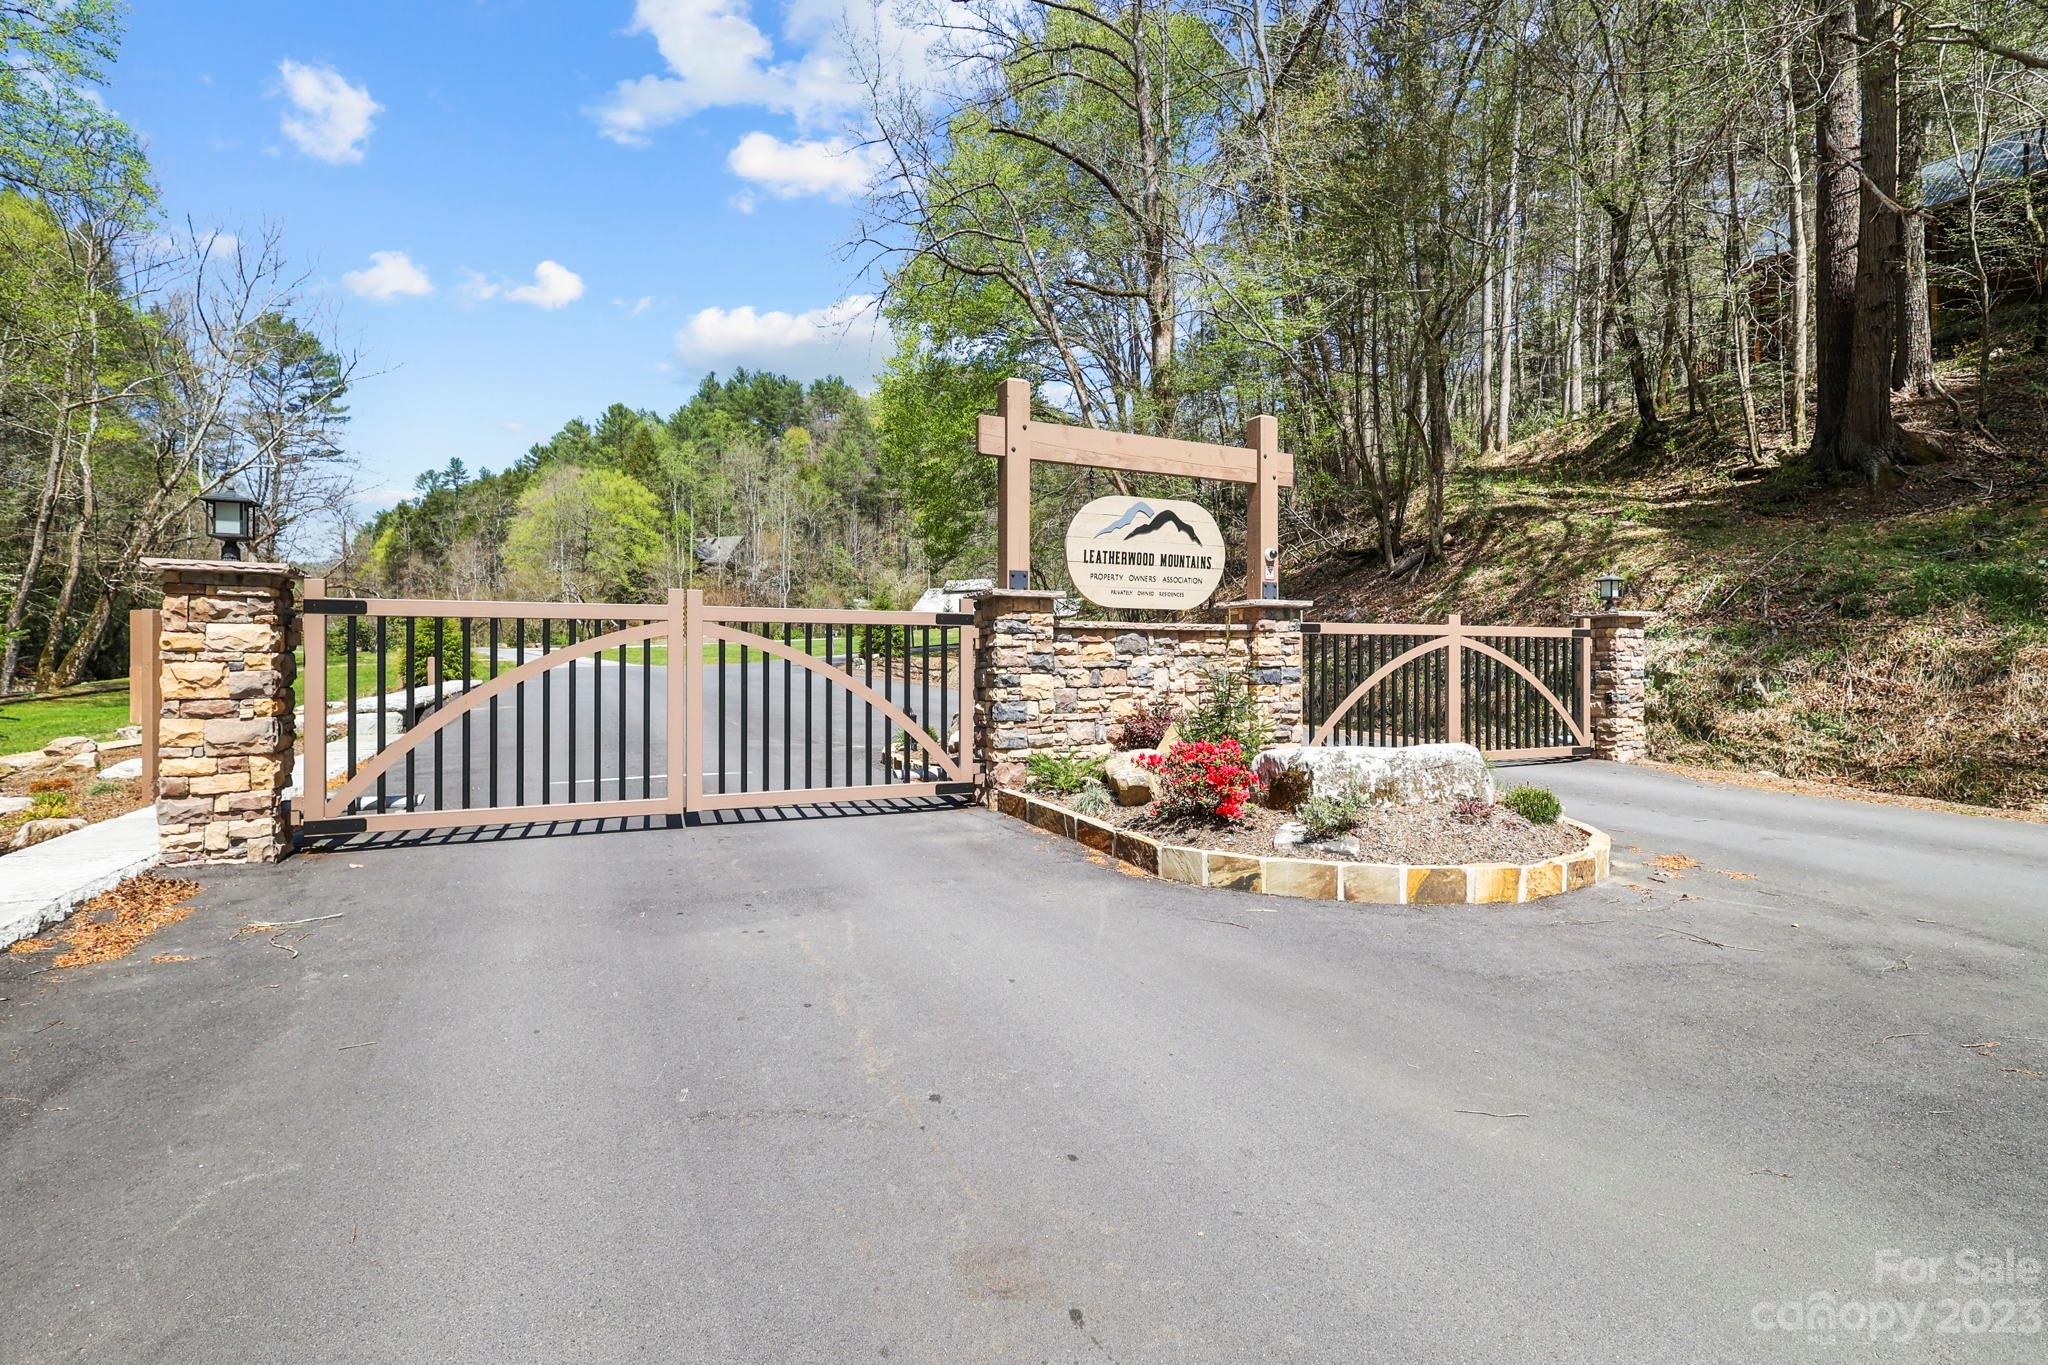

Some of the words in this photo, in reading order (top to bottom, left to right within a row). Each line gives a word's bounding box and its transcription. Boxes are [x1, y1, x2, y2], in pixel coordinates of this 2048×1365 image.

[1083, 549, 1155, 566] LEATHERWOOD
[1160, 553, 1212, 569] MOUNTAINS
[1090, 572, 1123, 581] PROPERTY
[1128, 574, 1156, 583] OWNERS
[1162, 576, 1203, 585] ASSOCIATION
